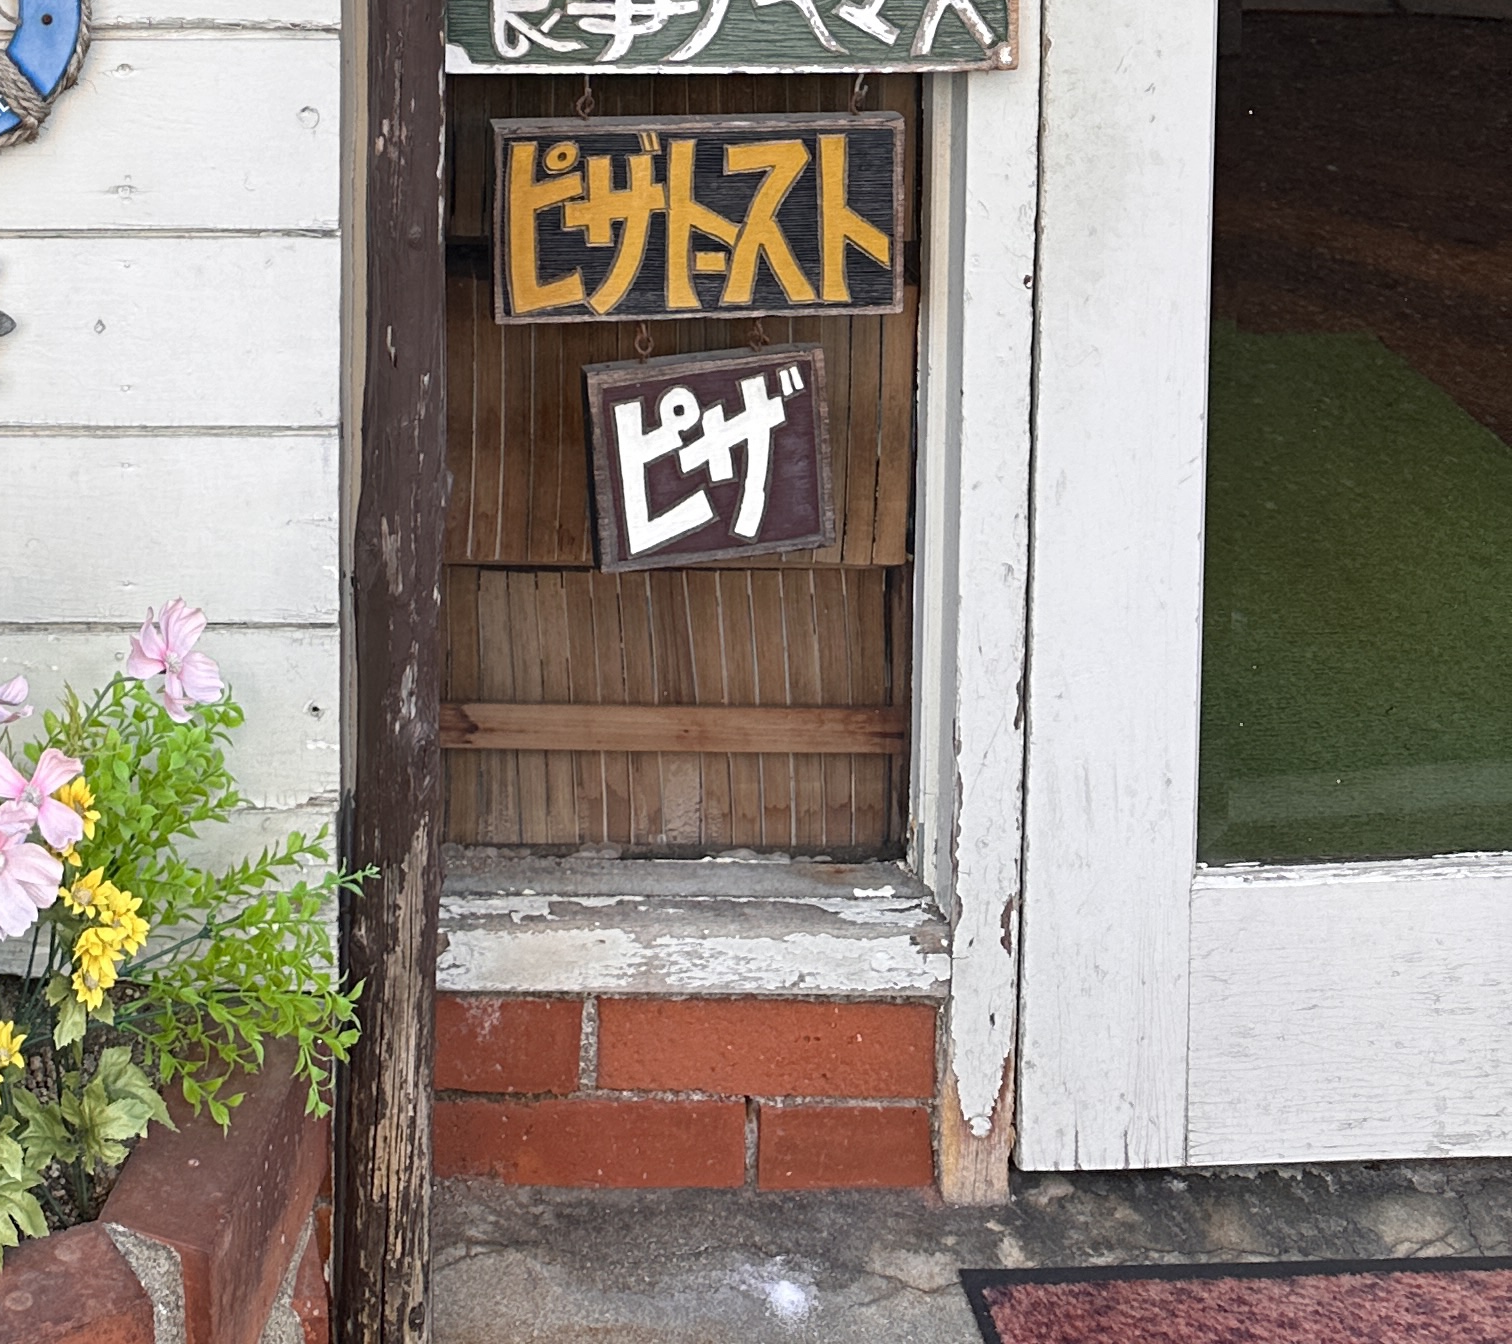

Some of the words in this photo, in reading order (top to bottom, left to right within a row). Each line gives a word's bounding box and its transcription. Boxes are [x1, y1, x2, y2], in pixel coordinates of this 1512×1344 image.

[508, 131, 892, 316] ピザトースト
[612, 362, 805, 559] ピザ
